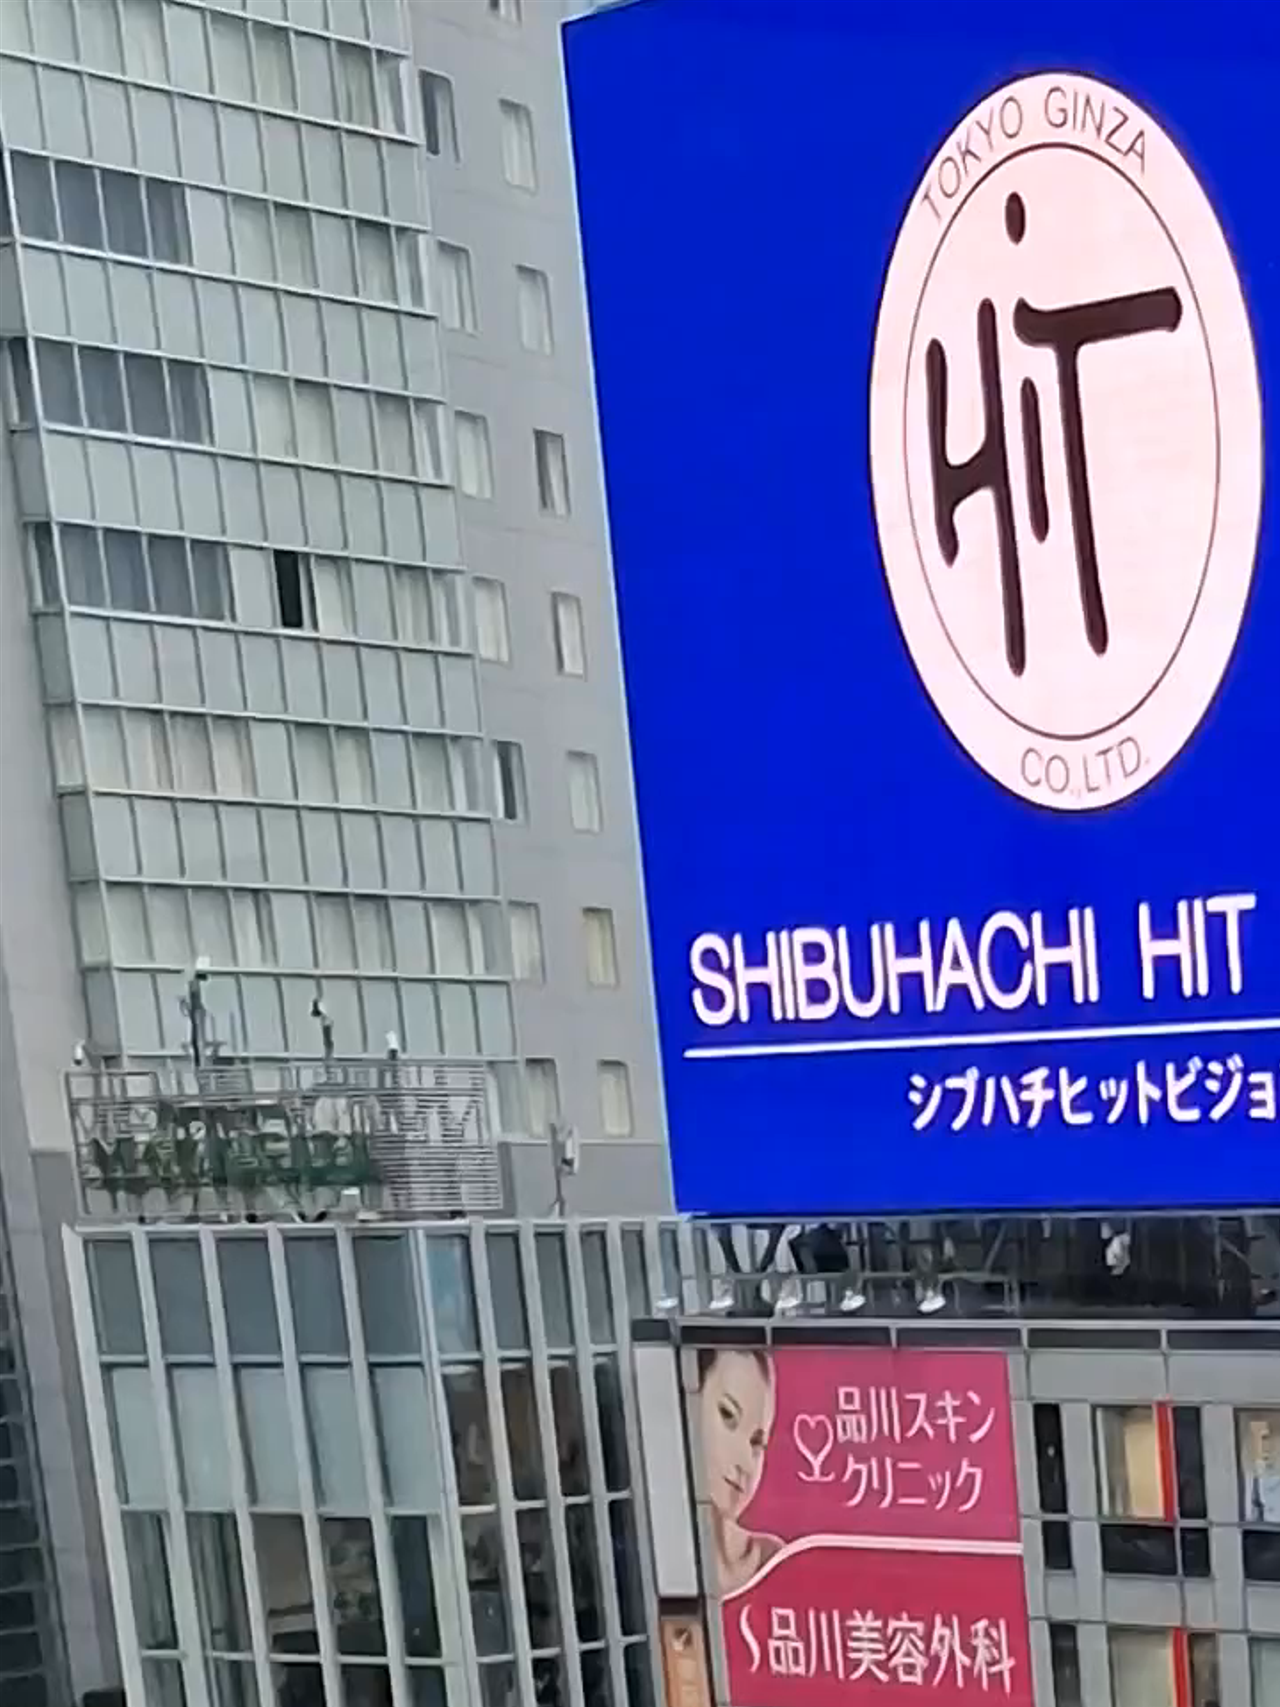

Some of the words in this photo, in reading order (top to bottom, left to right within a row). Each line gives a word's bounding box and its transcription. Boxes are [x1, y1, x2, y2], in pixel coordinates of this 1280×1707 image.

[920, 96, 1024, 222] TOKYO
[1042, 86, 1149, 175] GINZA
[690, 906, 1100, 1026] SHIBUHACHI
[1139, 892, 1256, 996] HIT
[835, 1385, 998, 1446] 品川スキン
[840, 1455, 985, 1514] クリニック
[766, 1605, 1017, 1694] 品川美容外科
